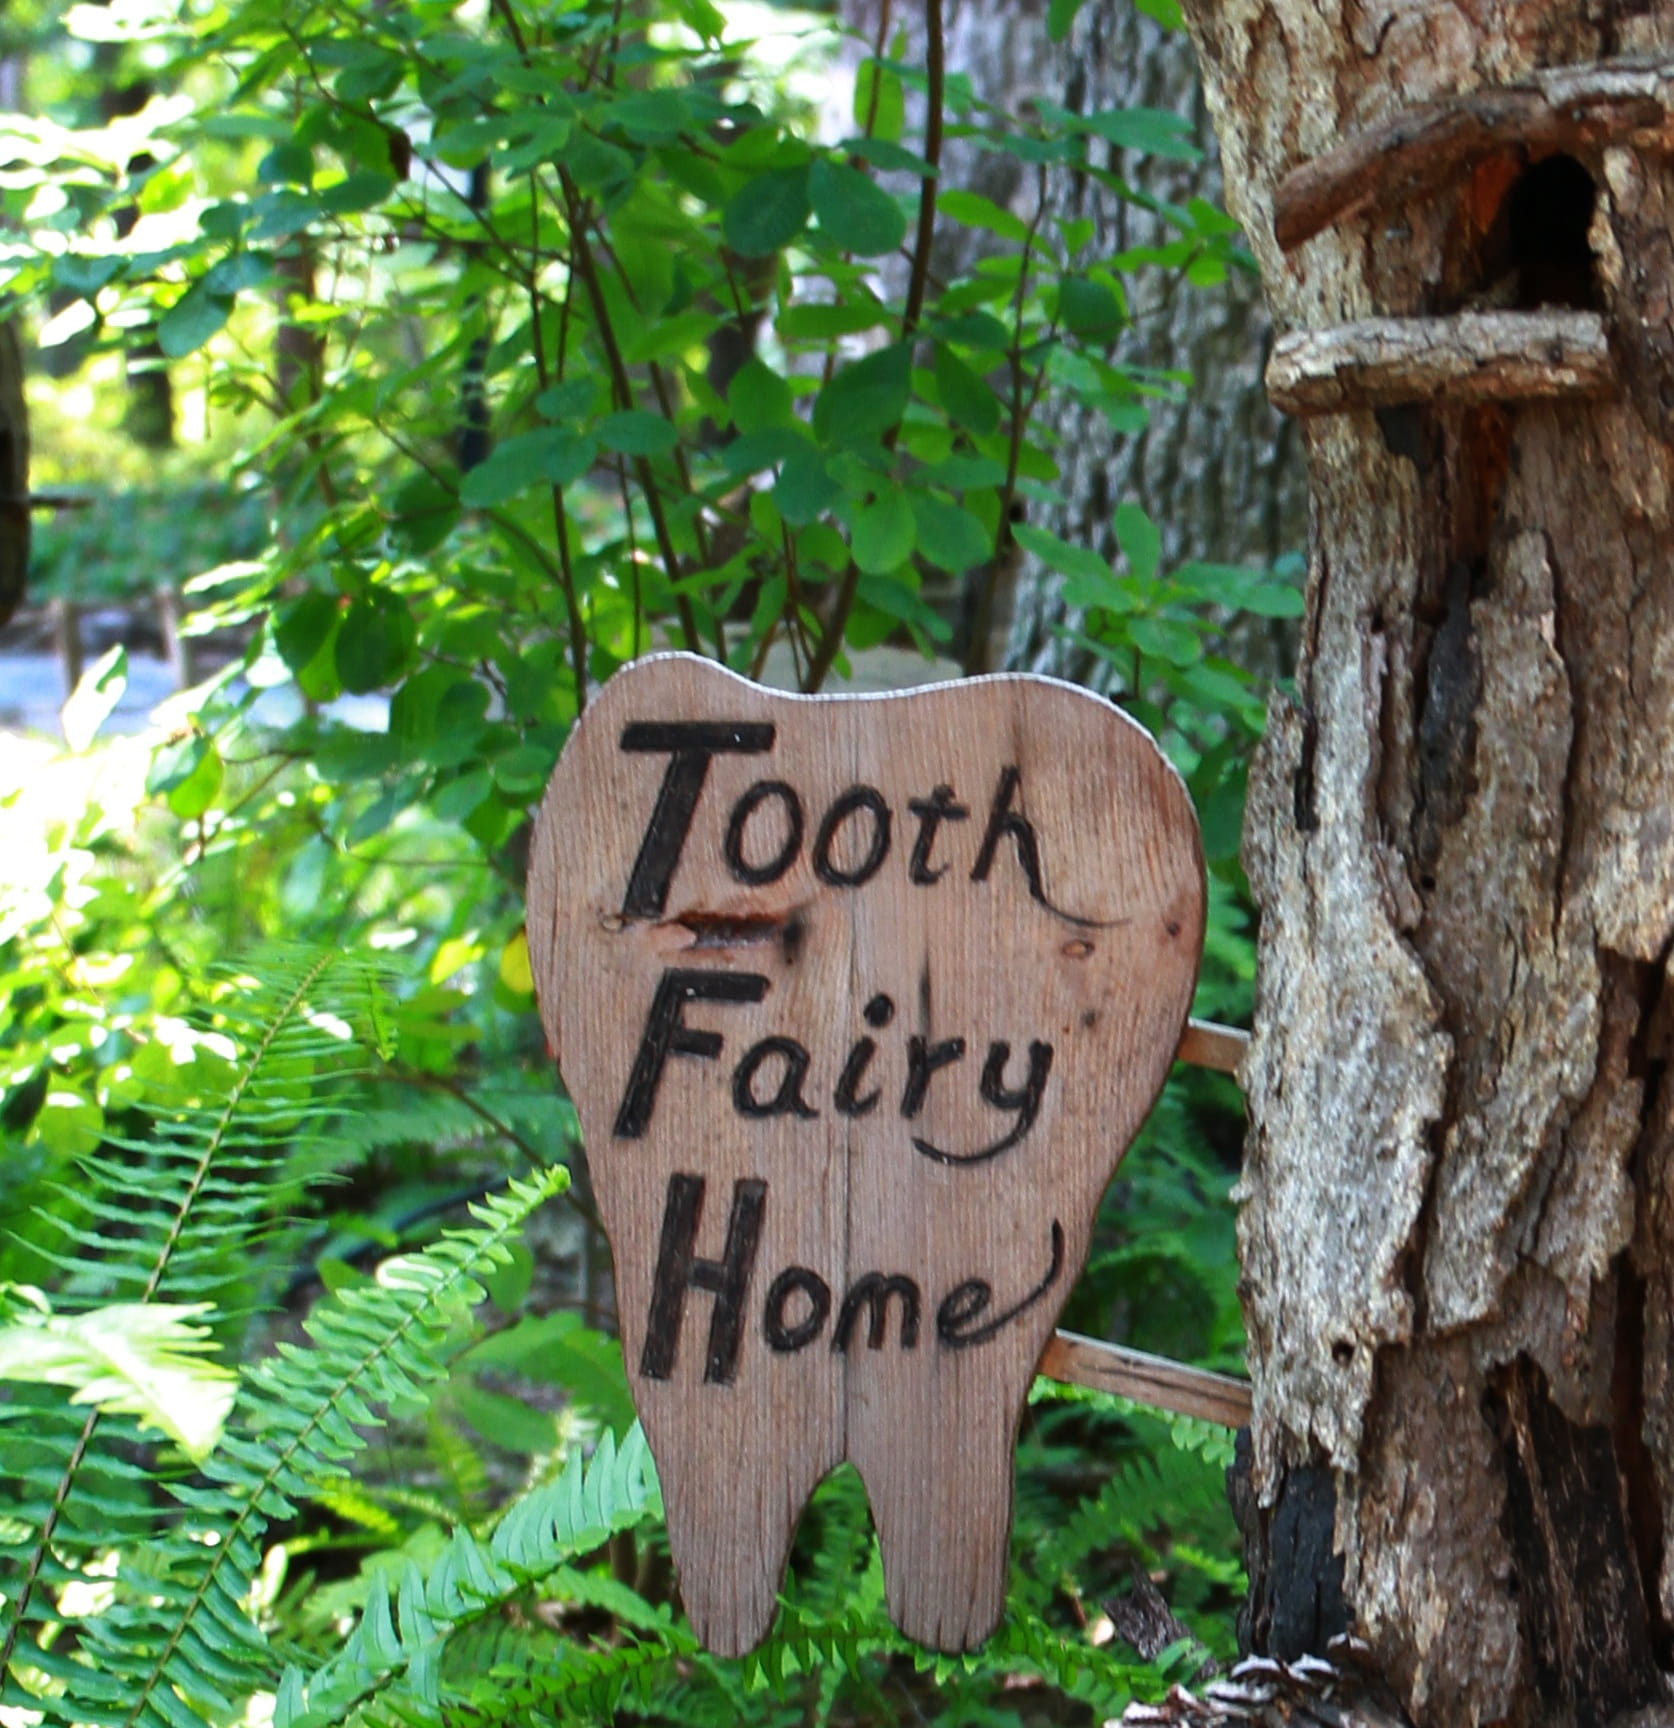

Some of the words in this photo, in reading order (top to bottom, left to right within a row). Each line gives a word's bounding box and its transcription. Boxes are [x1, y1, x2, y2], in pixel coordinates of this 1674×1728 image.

[619, 720, 1132, 928] Tooth
[612, 967, 1055, 1166] Fairy
[639, 1173, 1065, 1385] Home
